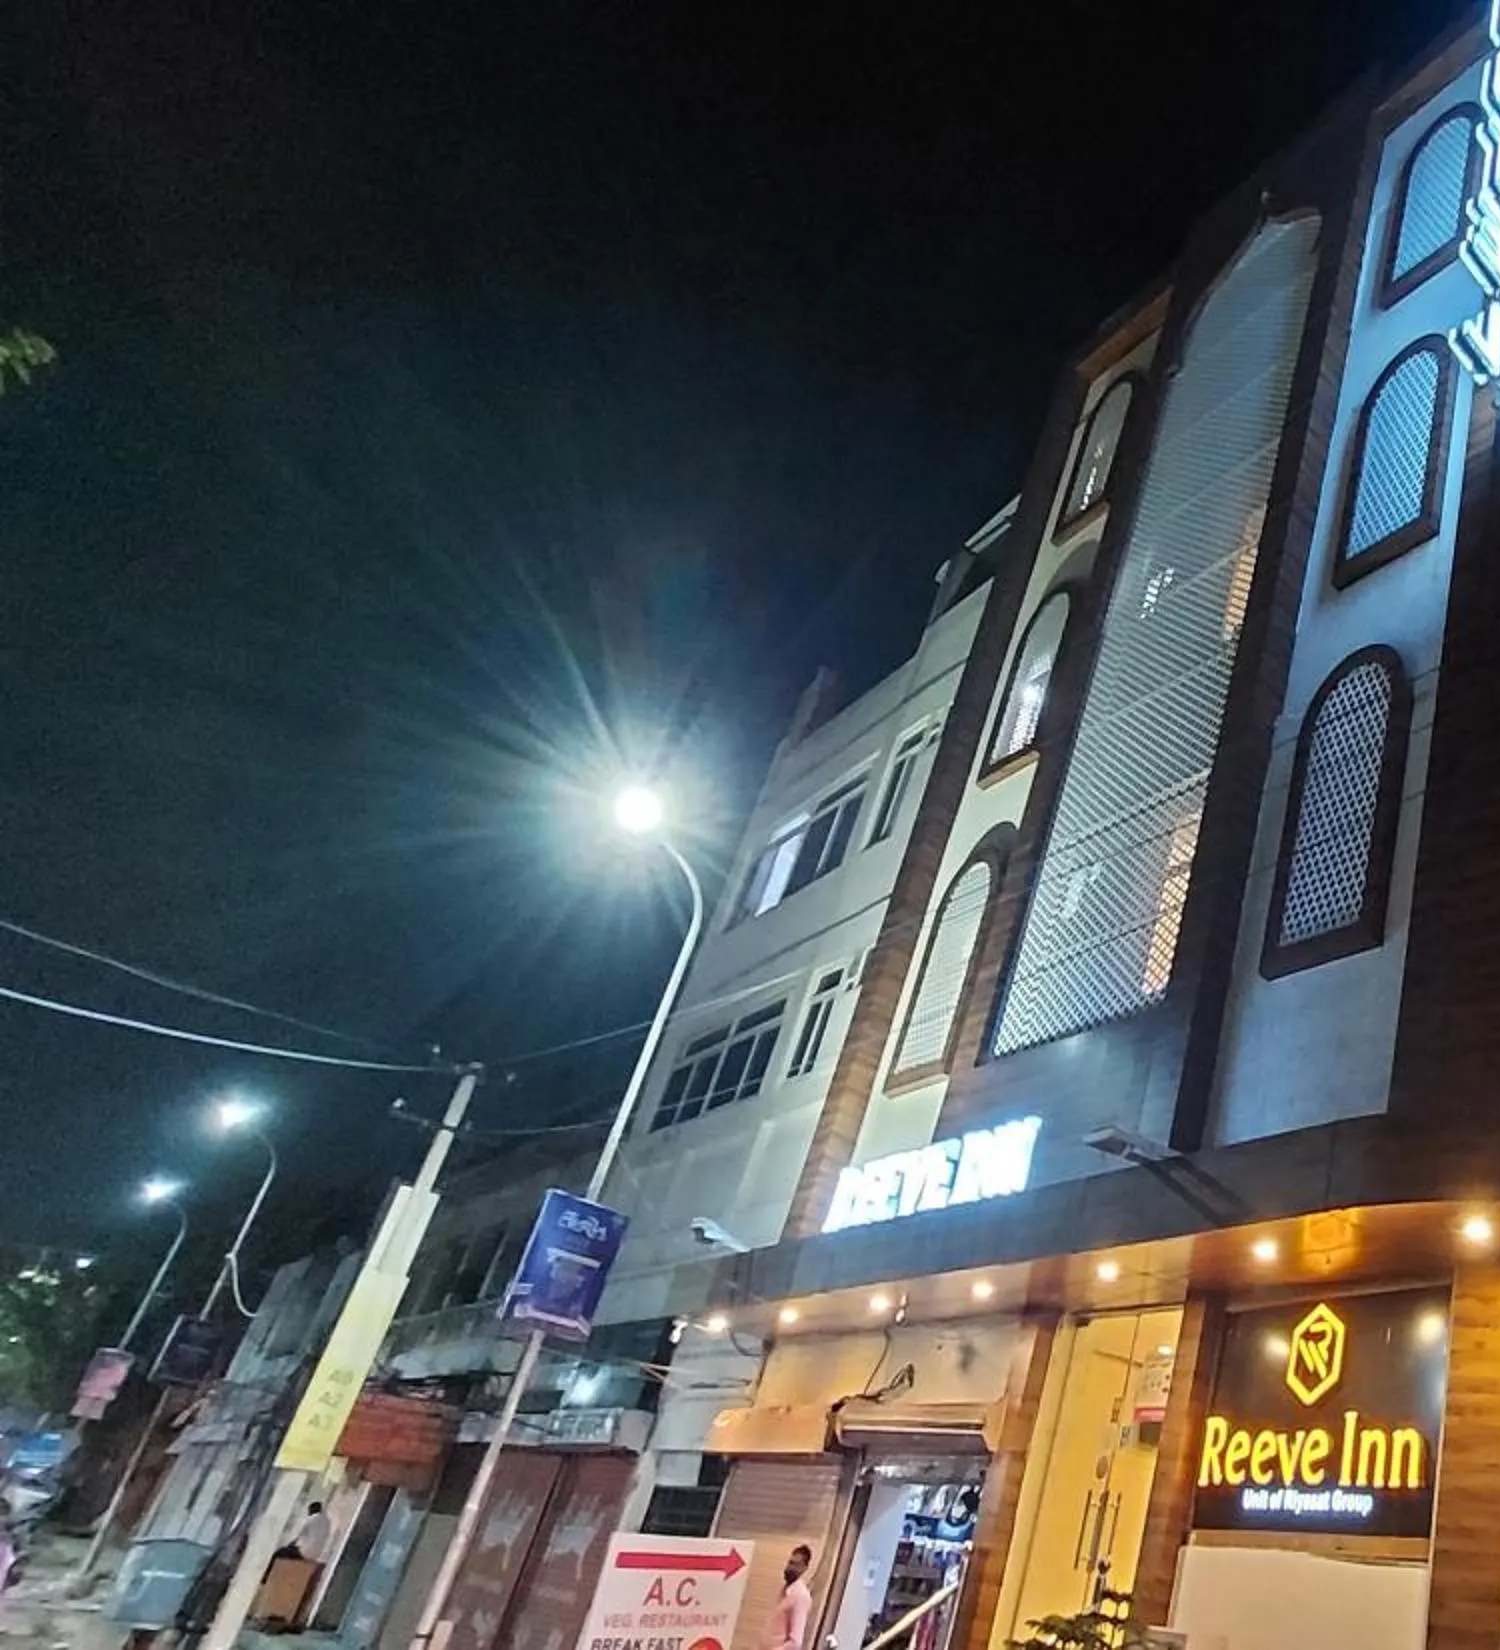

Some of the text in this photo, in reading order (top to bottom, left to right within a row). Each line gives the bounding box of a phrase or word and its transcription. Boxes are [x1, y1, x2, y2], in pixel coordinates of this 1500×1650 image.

[1198, 1411, 1422, 1488] Reeve Inn
[1243, 1489, 1268, 1510] Unit
[1269, 1489, 1284, 1510] of
[1332, 1489, 1373, 1516] Group
[643, 1577, 701, 1606] A.C.
[640, 1613, 729, 1628] RESTAURANT
